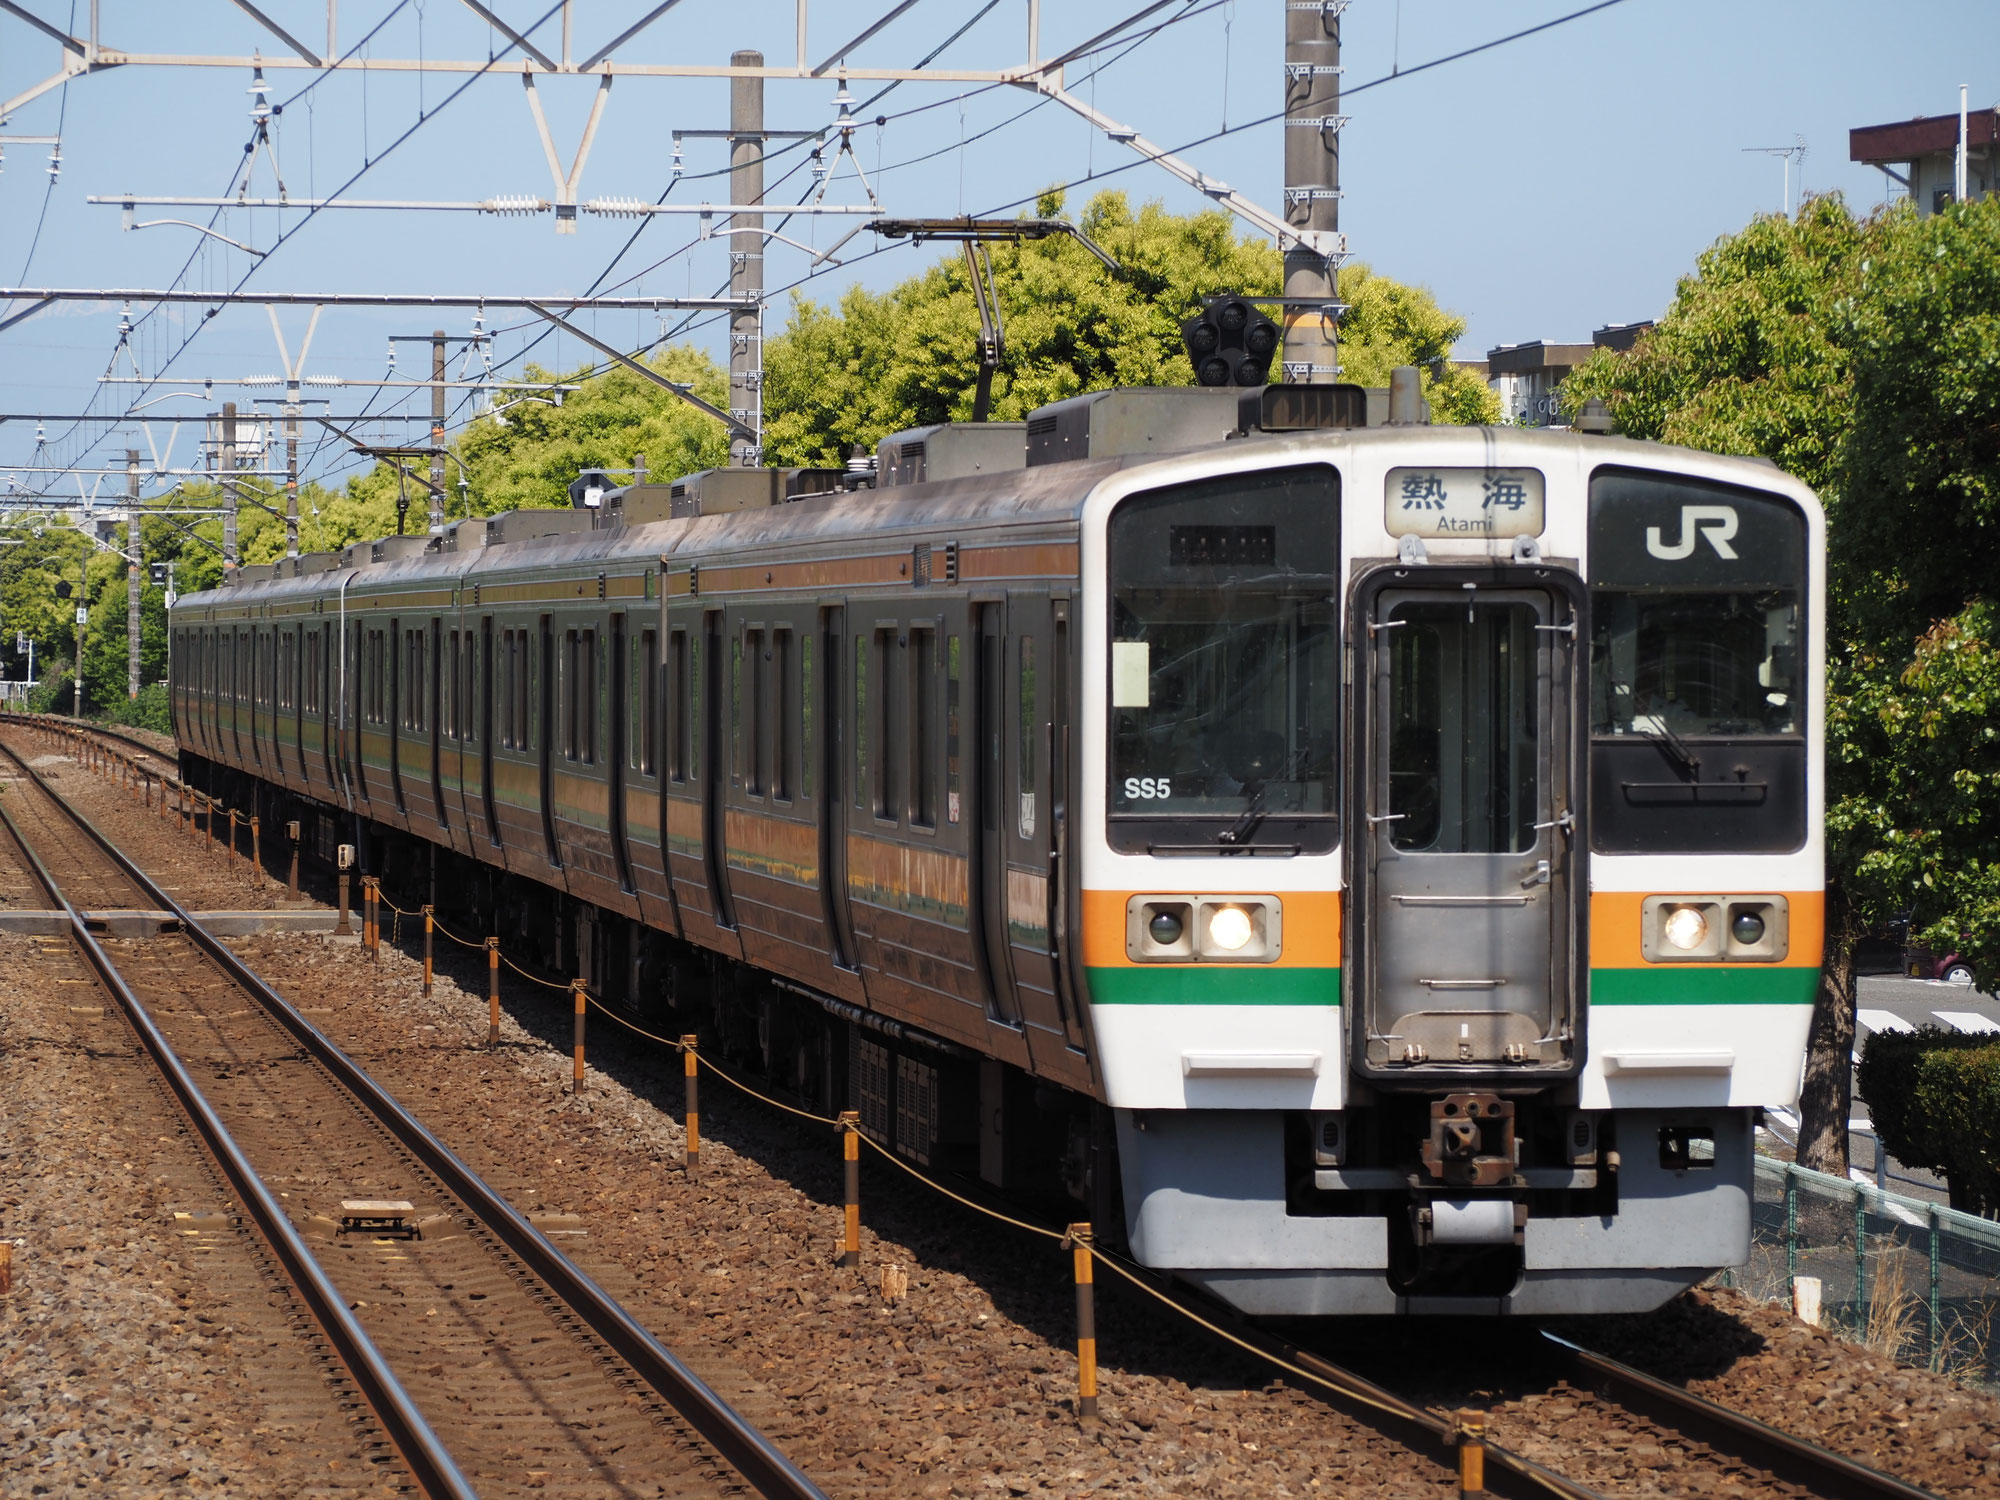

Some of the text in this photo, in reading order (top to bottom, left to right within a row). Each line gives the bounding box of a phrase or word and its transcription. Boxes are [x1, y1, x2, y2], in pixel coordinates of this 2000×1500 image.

[1436, 516, 1493, 532] Atami
[1646, 505, 1739, 560] JR
[1124, 777, 1171, 799] SS5
